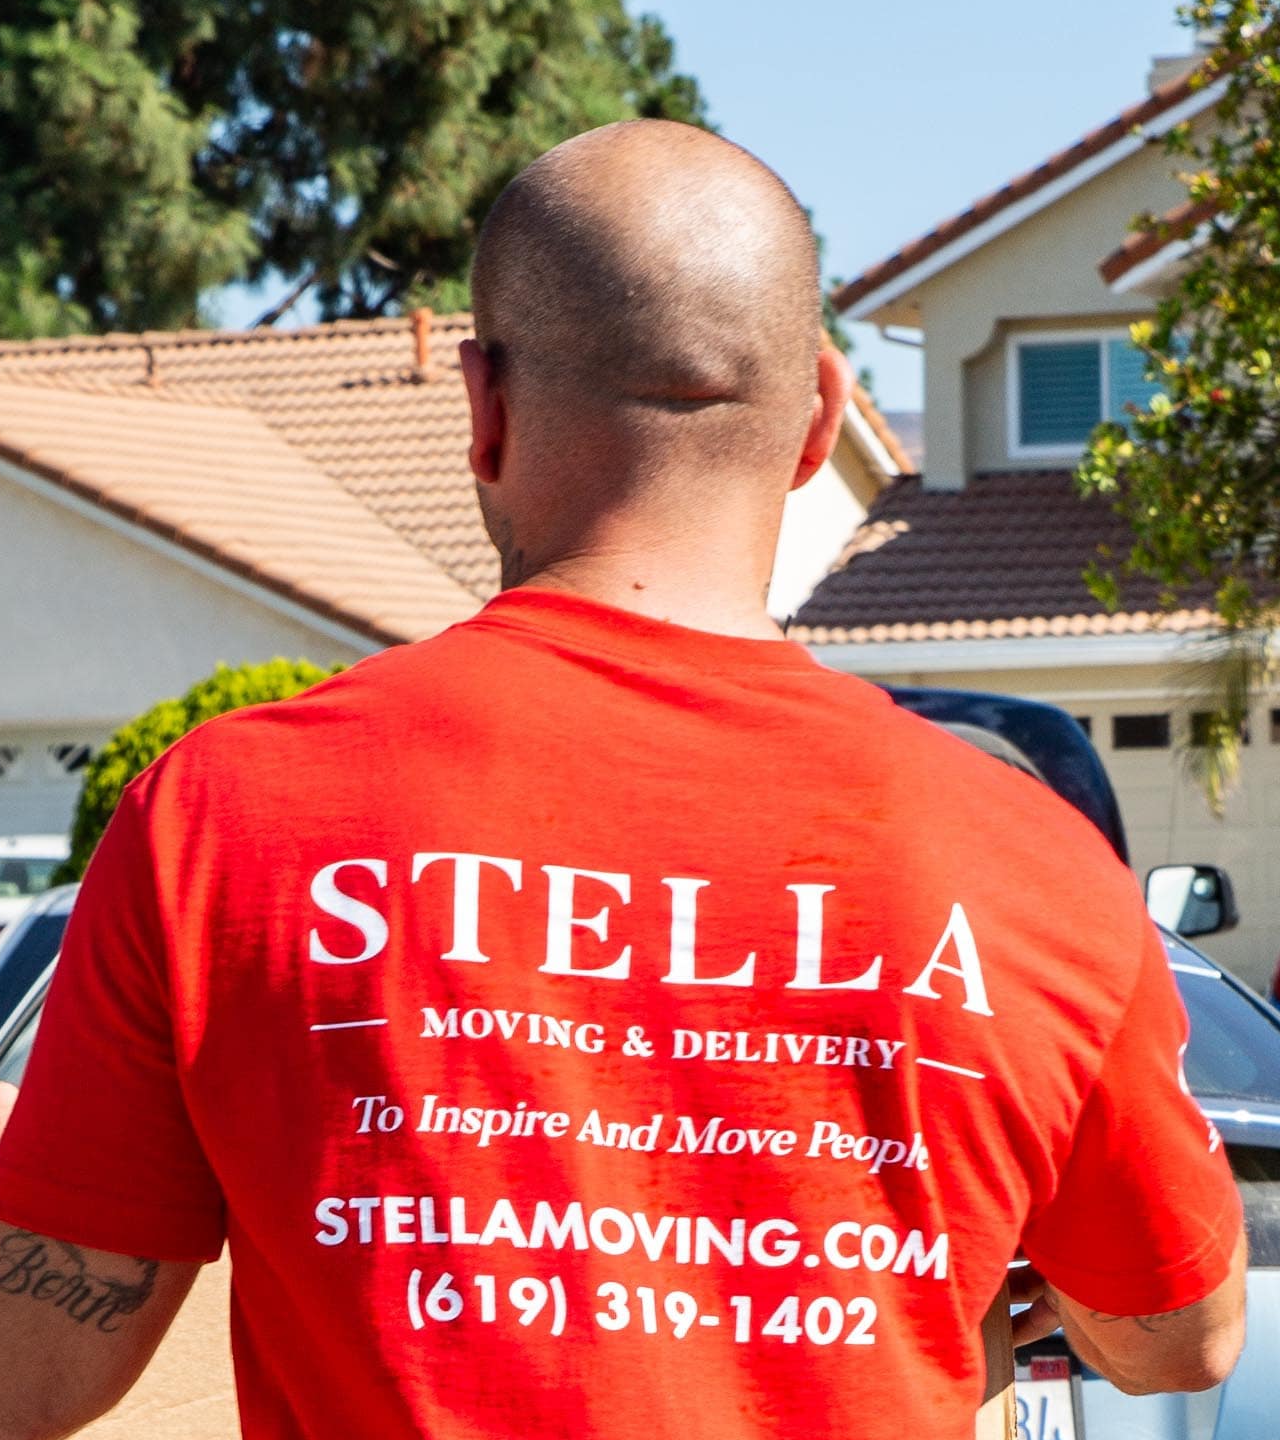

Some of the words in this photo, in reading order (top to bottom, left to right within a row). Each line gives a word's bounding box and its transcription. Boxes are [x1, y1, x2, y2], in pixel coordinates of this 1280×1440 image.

[309, 851, 995, 1018] STELLA
[419, 1007, 606, 1054] MOVING
[621, 1025, 655, 1058] &
[671, 1028, 907, 1069] DELIVERY
[352, 1095, 404, 1133] To
[415, 1094, 571, 1148] Inspire
[575, 1108, 664, 1152] And
[666, 1116, 798, 1156] Move
[315, 1195, 949, 1280] STELLAMOVING.COM
[407, 1268, 567, 1337] (619)
[594, 1281, 878, 1346] 319-1402
